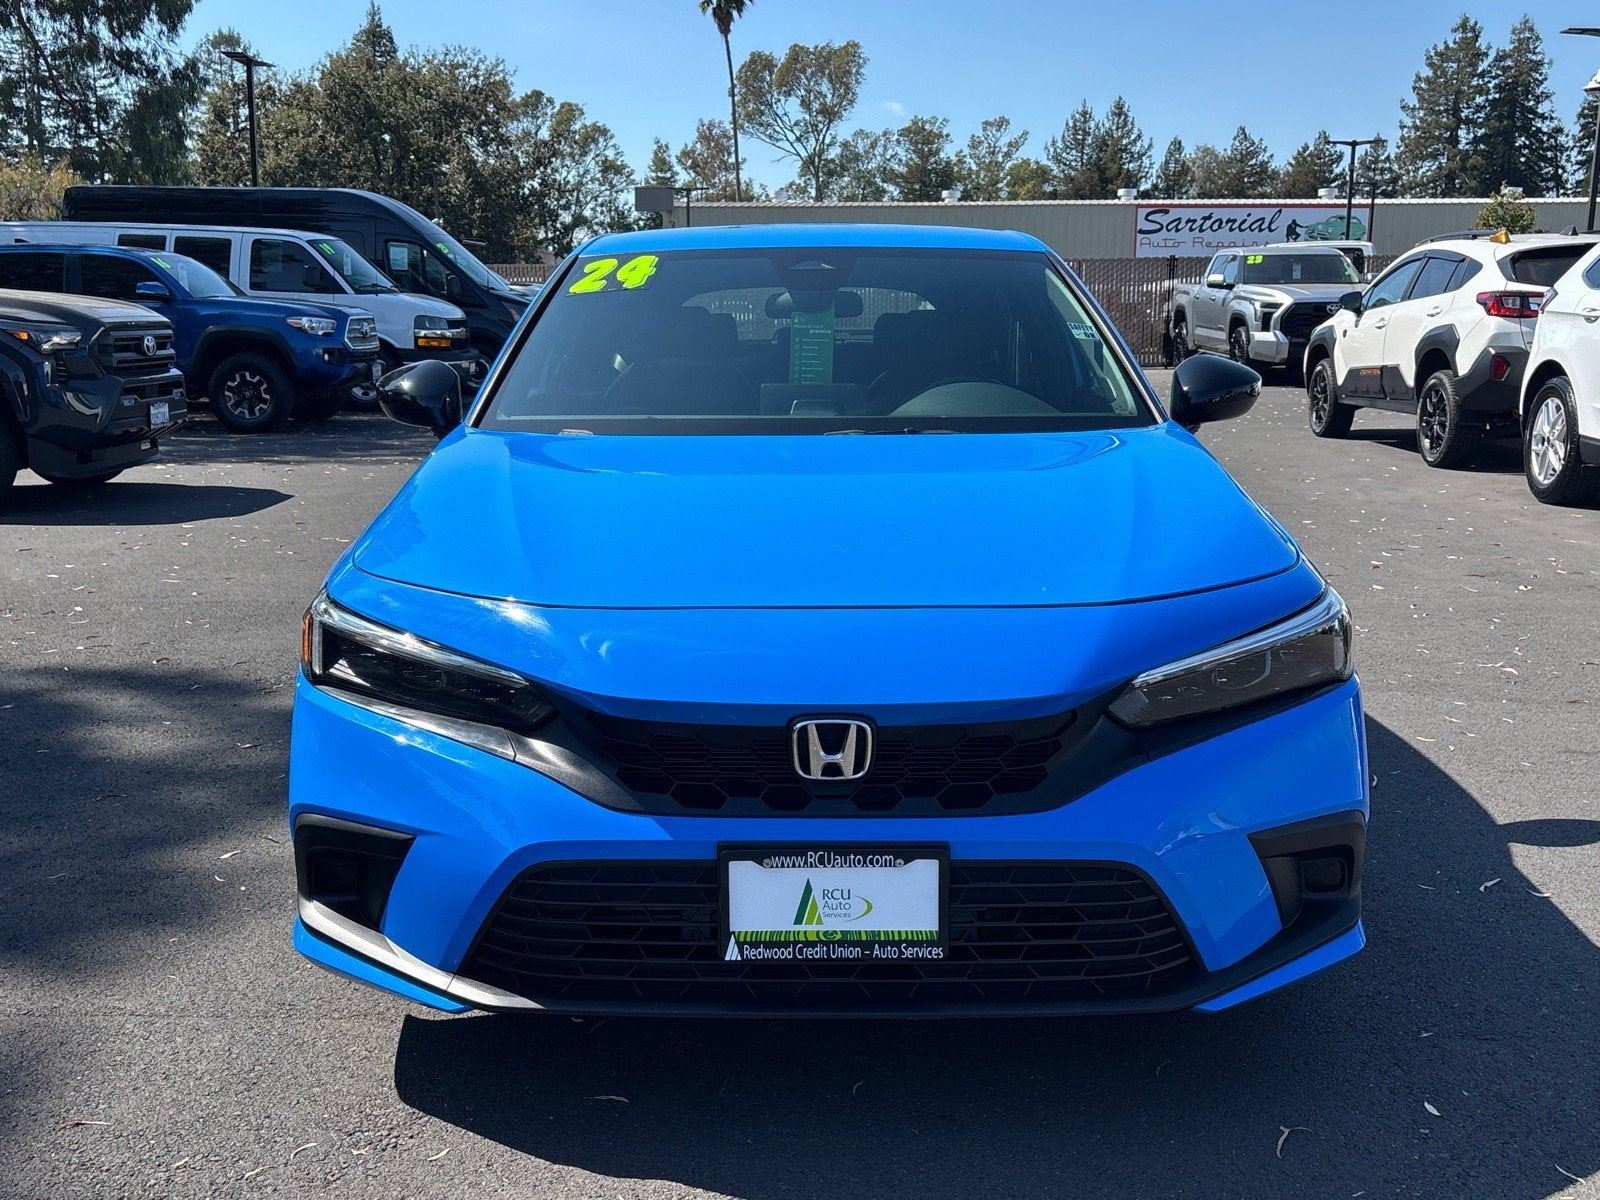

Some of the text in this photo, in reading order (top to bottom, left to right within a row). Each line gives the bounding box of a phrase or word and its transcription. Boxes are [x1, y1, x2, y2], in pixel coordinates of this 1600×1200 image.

[1137, 208, 1282, 235] Sartorial
[1140, 236, 1186, 248] Auto
[568, 255, 660, 294] 24
[1083, 331, 1097, 339] OK
[771, 851, 895, 868] www.RCUauto.com
[822, 888, 851, 901] RCU
[822, 900, 852, 911] Auto
[743, 943, 793, 960] Redwood
[795, 943, 828, 959] Credit
[829, 943, 861, 959] Union
[872, 943, 899, 959] Auto
[900, 943, 944, 959] Services
